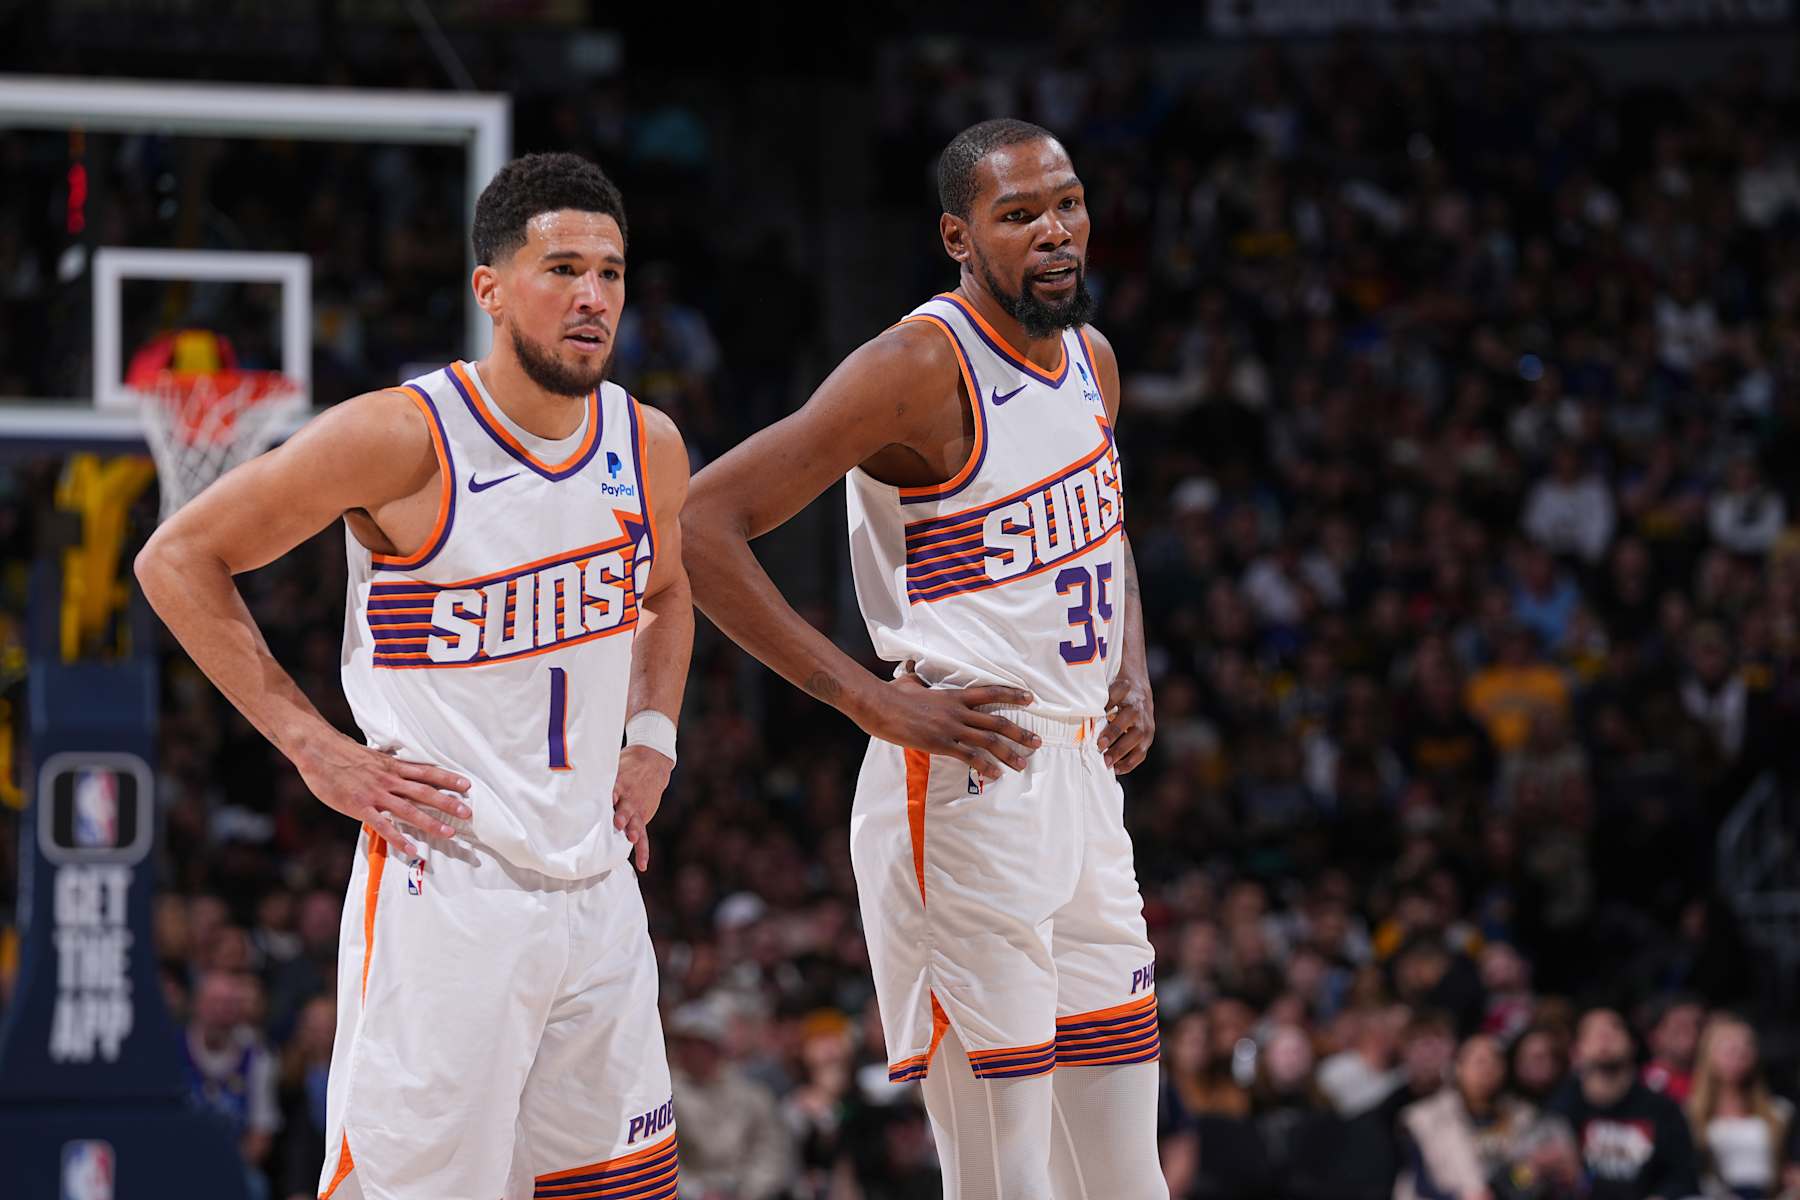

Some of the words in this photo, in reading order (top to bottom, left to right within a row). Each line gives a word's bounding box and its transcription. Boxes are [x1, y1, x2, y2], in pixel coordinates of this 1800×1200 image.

[601, 483, 634, 497] PayPal
[983, 454, 1119, 582] SUNS
[427, 551, 624, 662] SUNS
[1055, 561, 1112, 665] 35
[549, 667, 574, 771] 1
[54, 863, 133, 926] GET
[52, 928, 134, 989] THE
[49, 992, 134, 1063] APP
